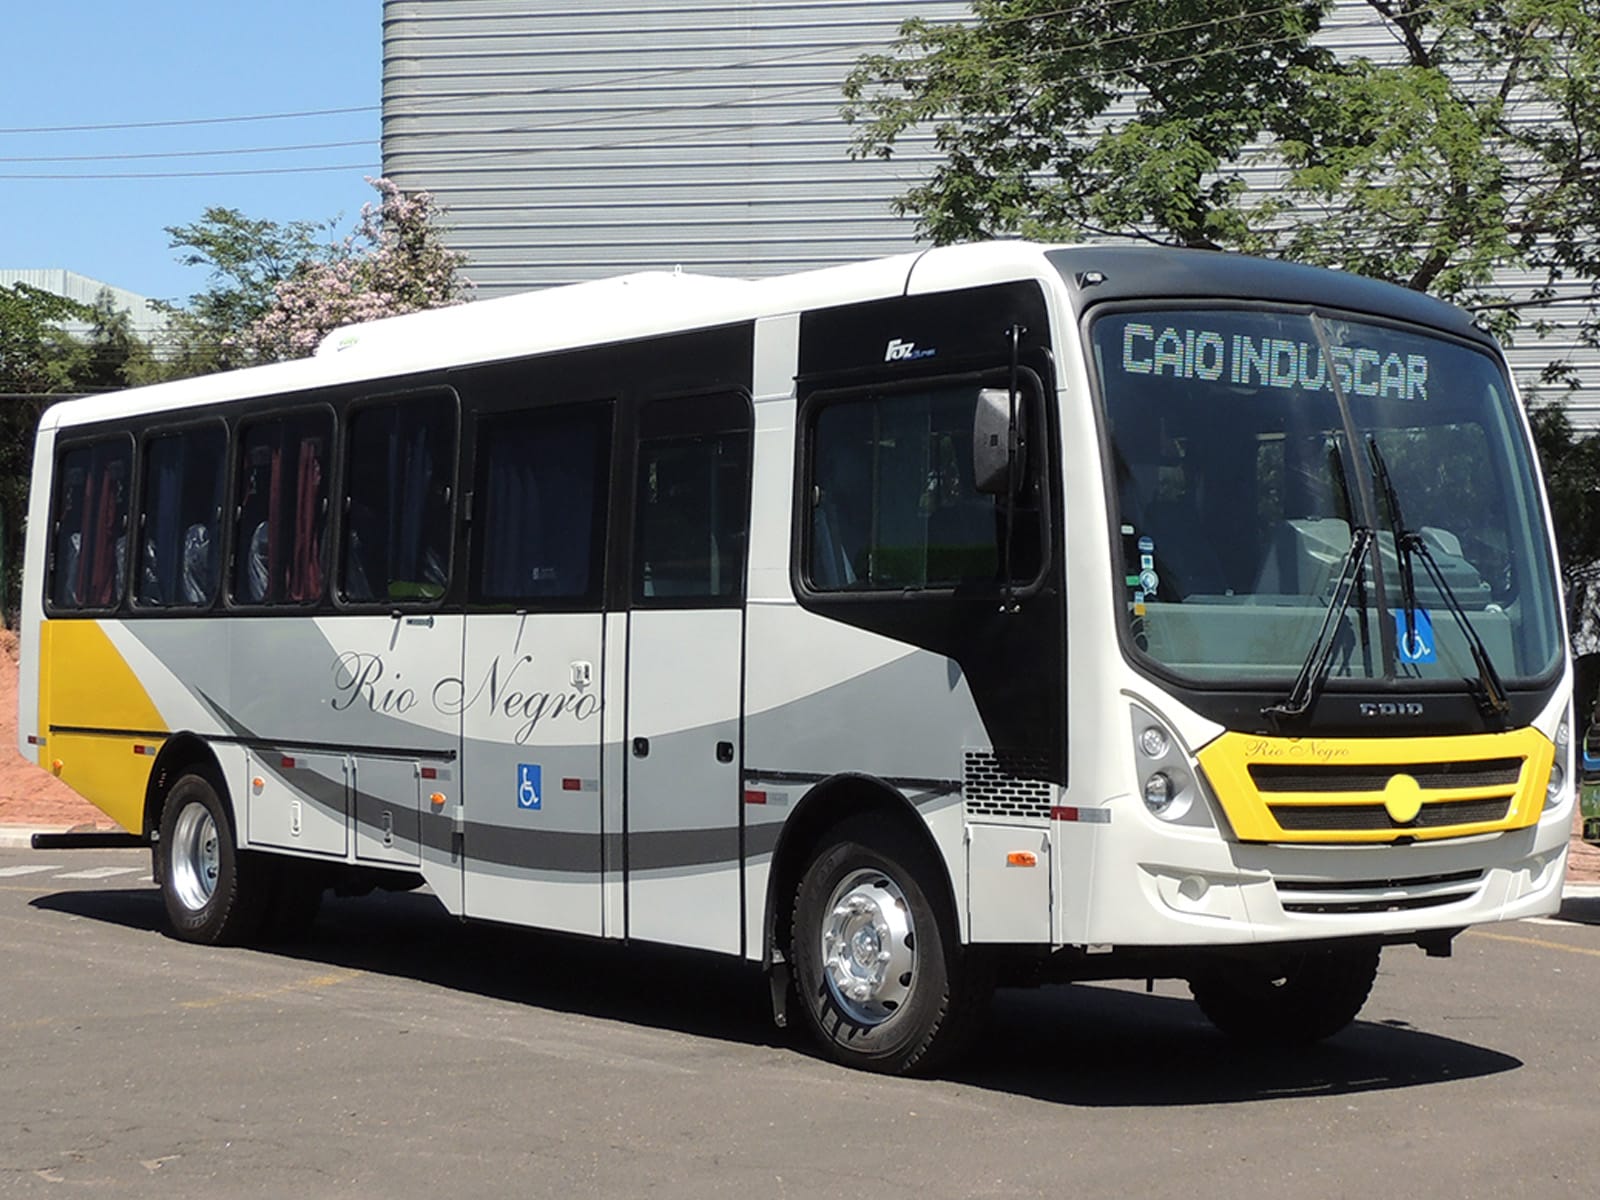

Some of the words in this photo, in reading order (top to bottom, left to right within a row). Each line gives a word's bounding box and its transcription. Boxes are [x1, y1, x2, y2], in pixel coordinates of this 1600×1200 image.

[1123, 323, 1224, 381] CAIO
[1231, 334, 1428, 400] INDUSCAR
[331, 651, 418, 713] Rio
[432, 655, 601, 745] Negro
[1360, 702, 1423, 715] CAIO
[1245, 739, 1284, 757] Rio
[1289, 740, 1349, 762] Negro
